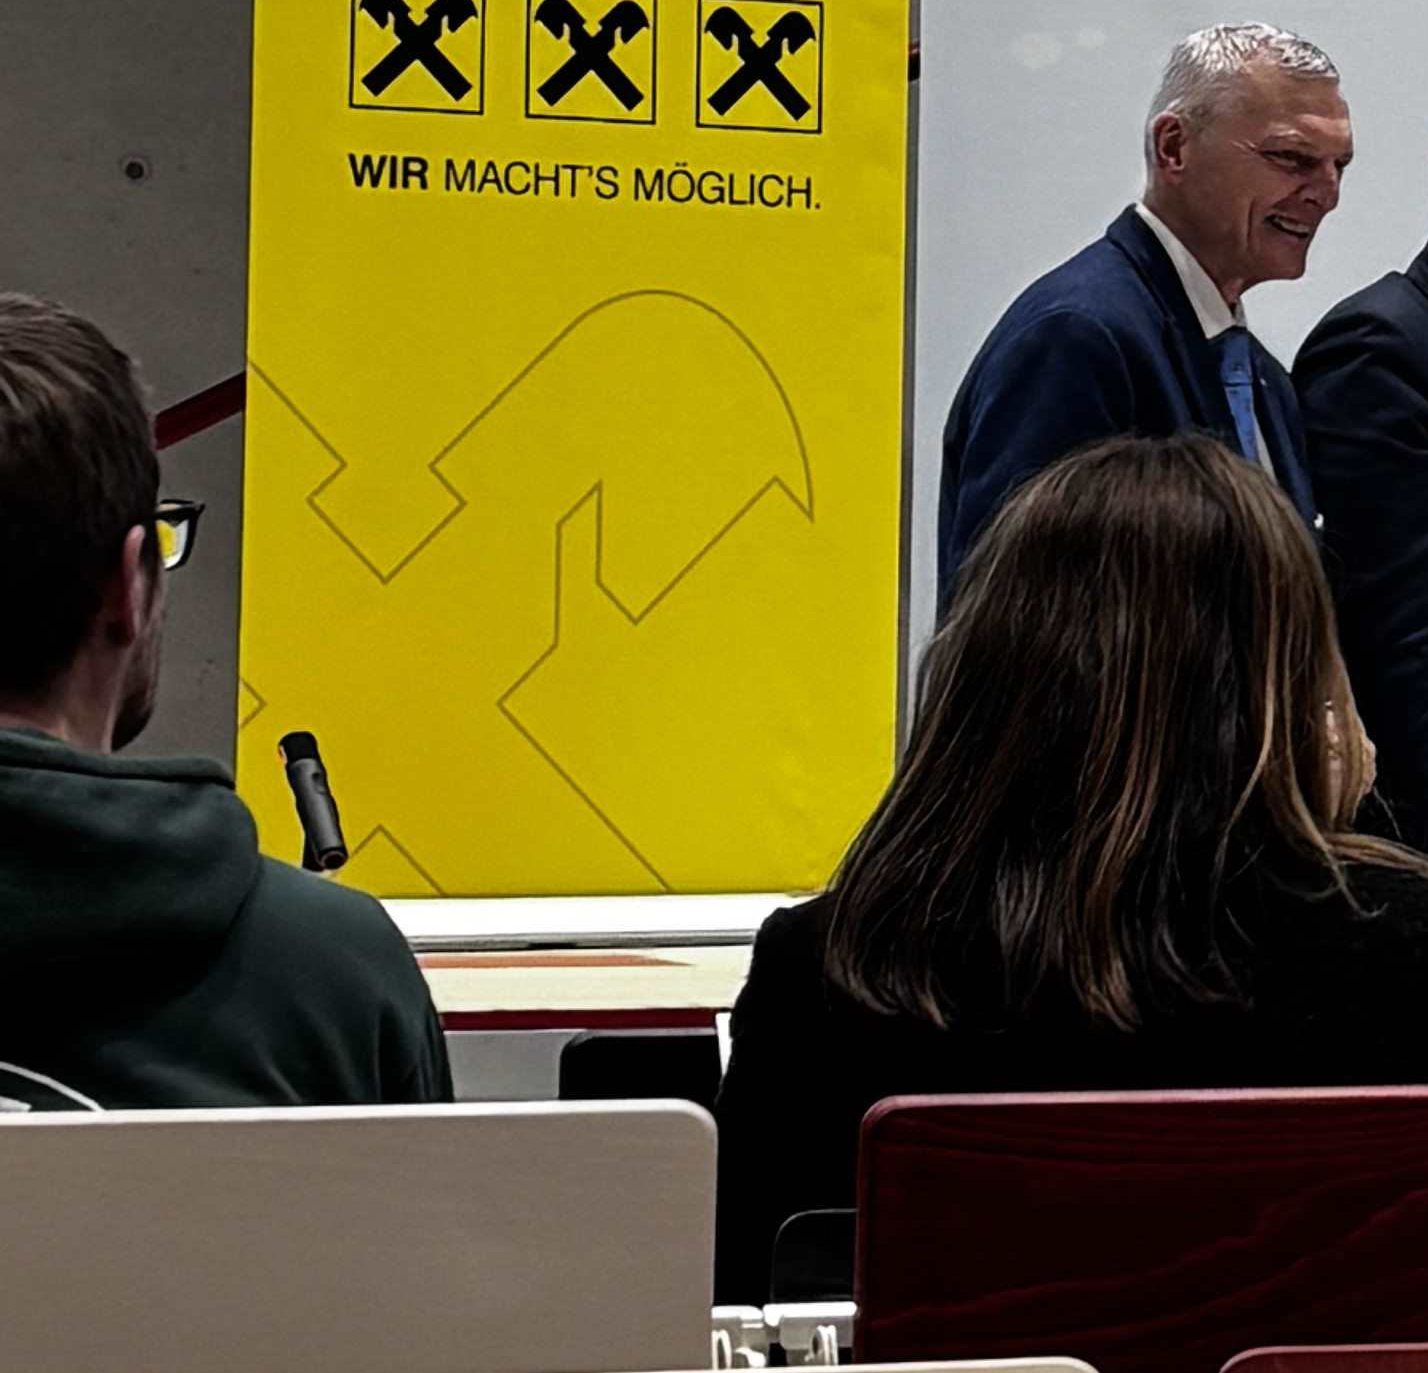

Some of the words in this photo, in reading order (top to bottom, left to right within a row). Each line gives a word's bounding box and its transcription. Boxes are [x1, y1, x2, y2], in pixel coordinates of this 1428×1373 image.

[348, 153, 428, 190] WIR
[444, 159, 620, 200] MACHT'S
[633, 162, 822, 210] MÖGLICH.
